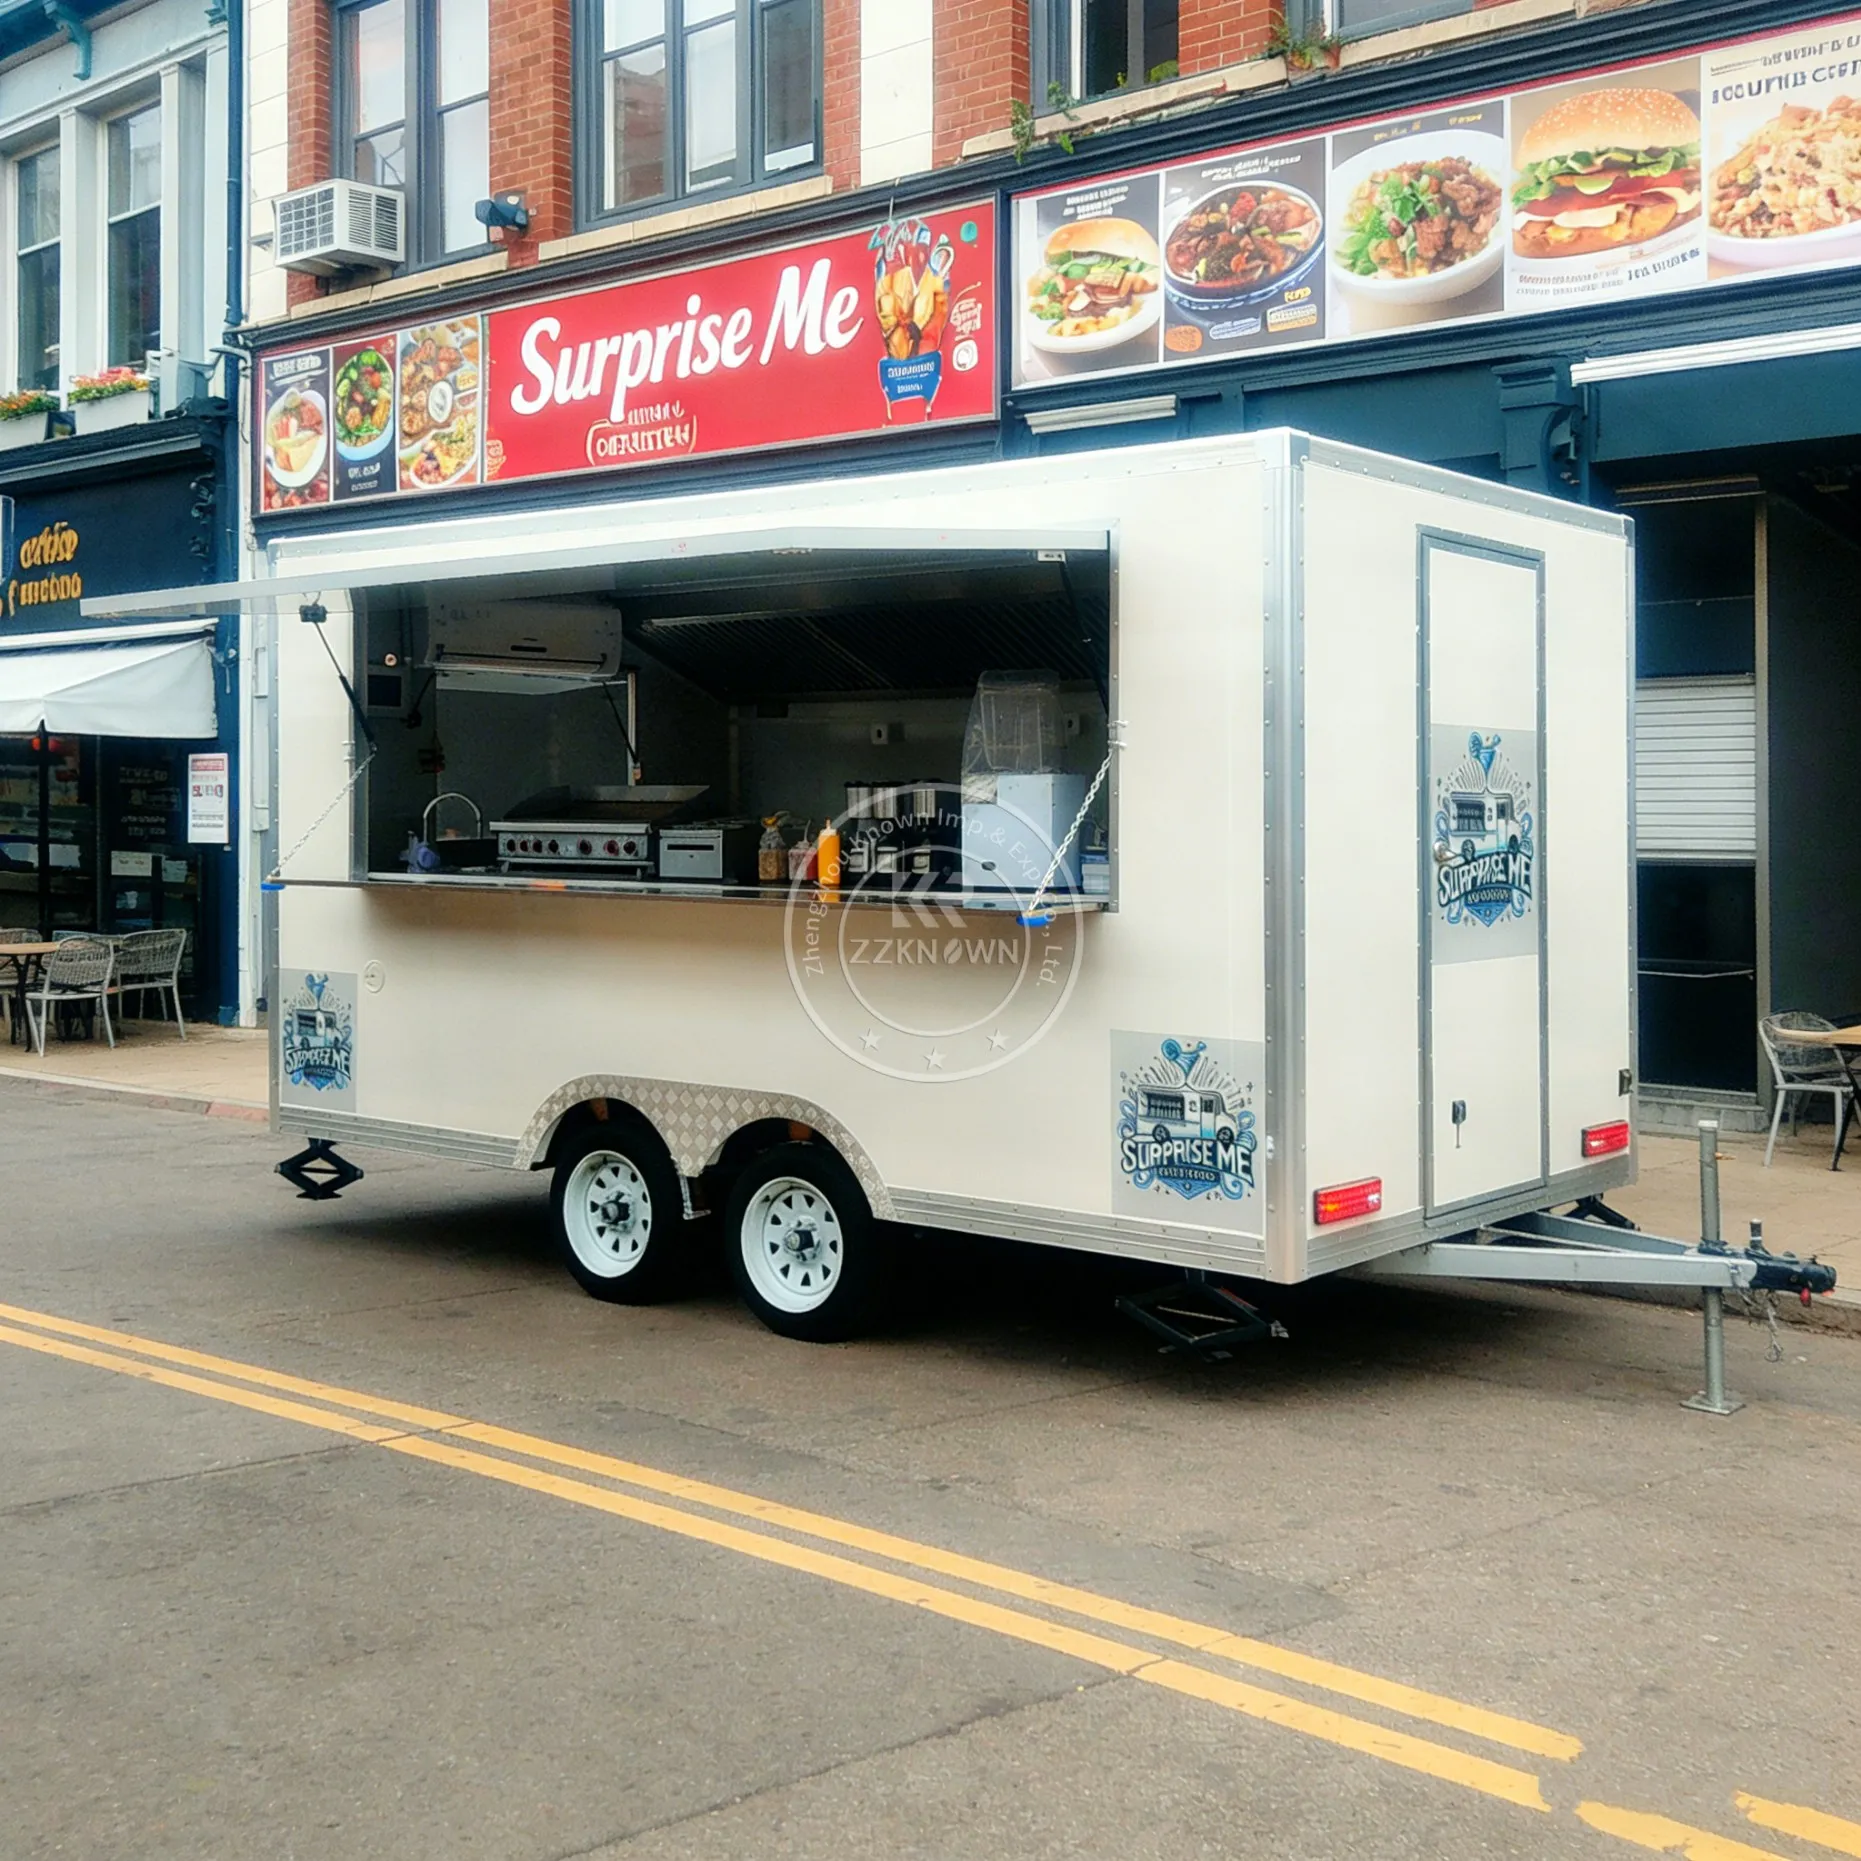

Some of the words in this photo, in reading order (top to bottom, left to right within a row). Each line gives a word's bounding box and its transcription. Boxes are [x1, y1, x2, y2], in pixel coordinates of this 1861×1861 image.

[510, 294, 754, 423] Surprise
[759, 258, 865, 366] Me
[1121, 1138, 1214, 1173] SURPRISE
[1217, 1141, 1252, 1185] ME
